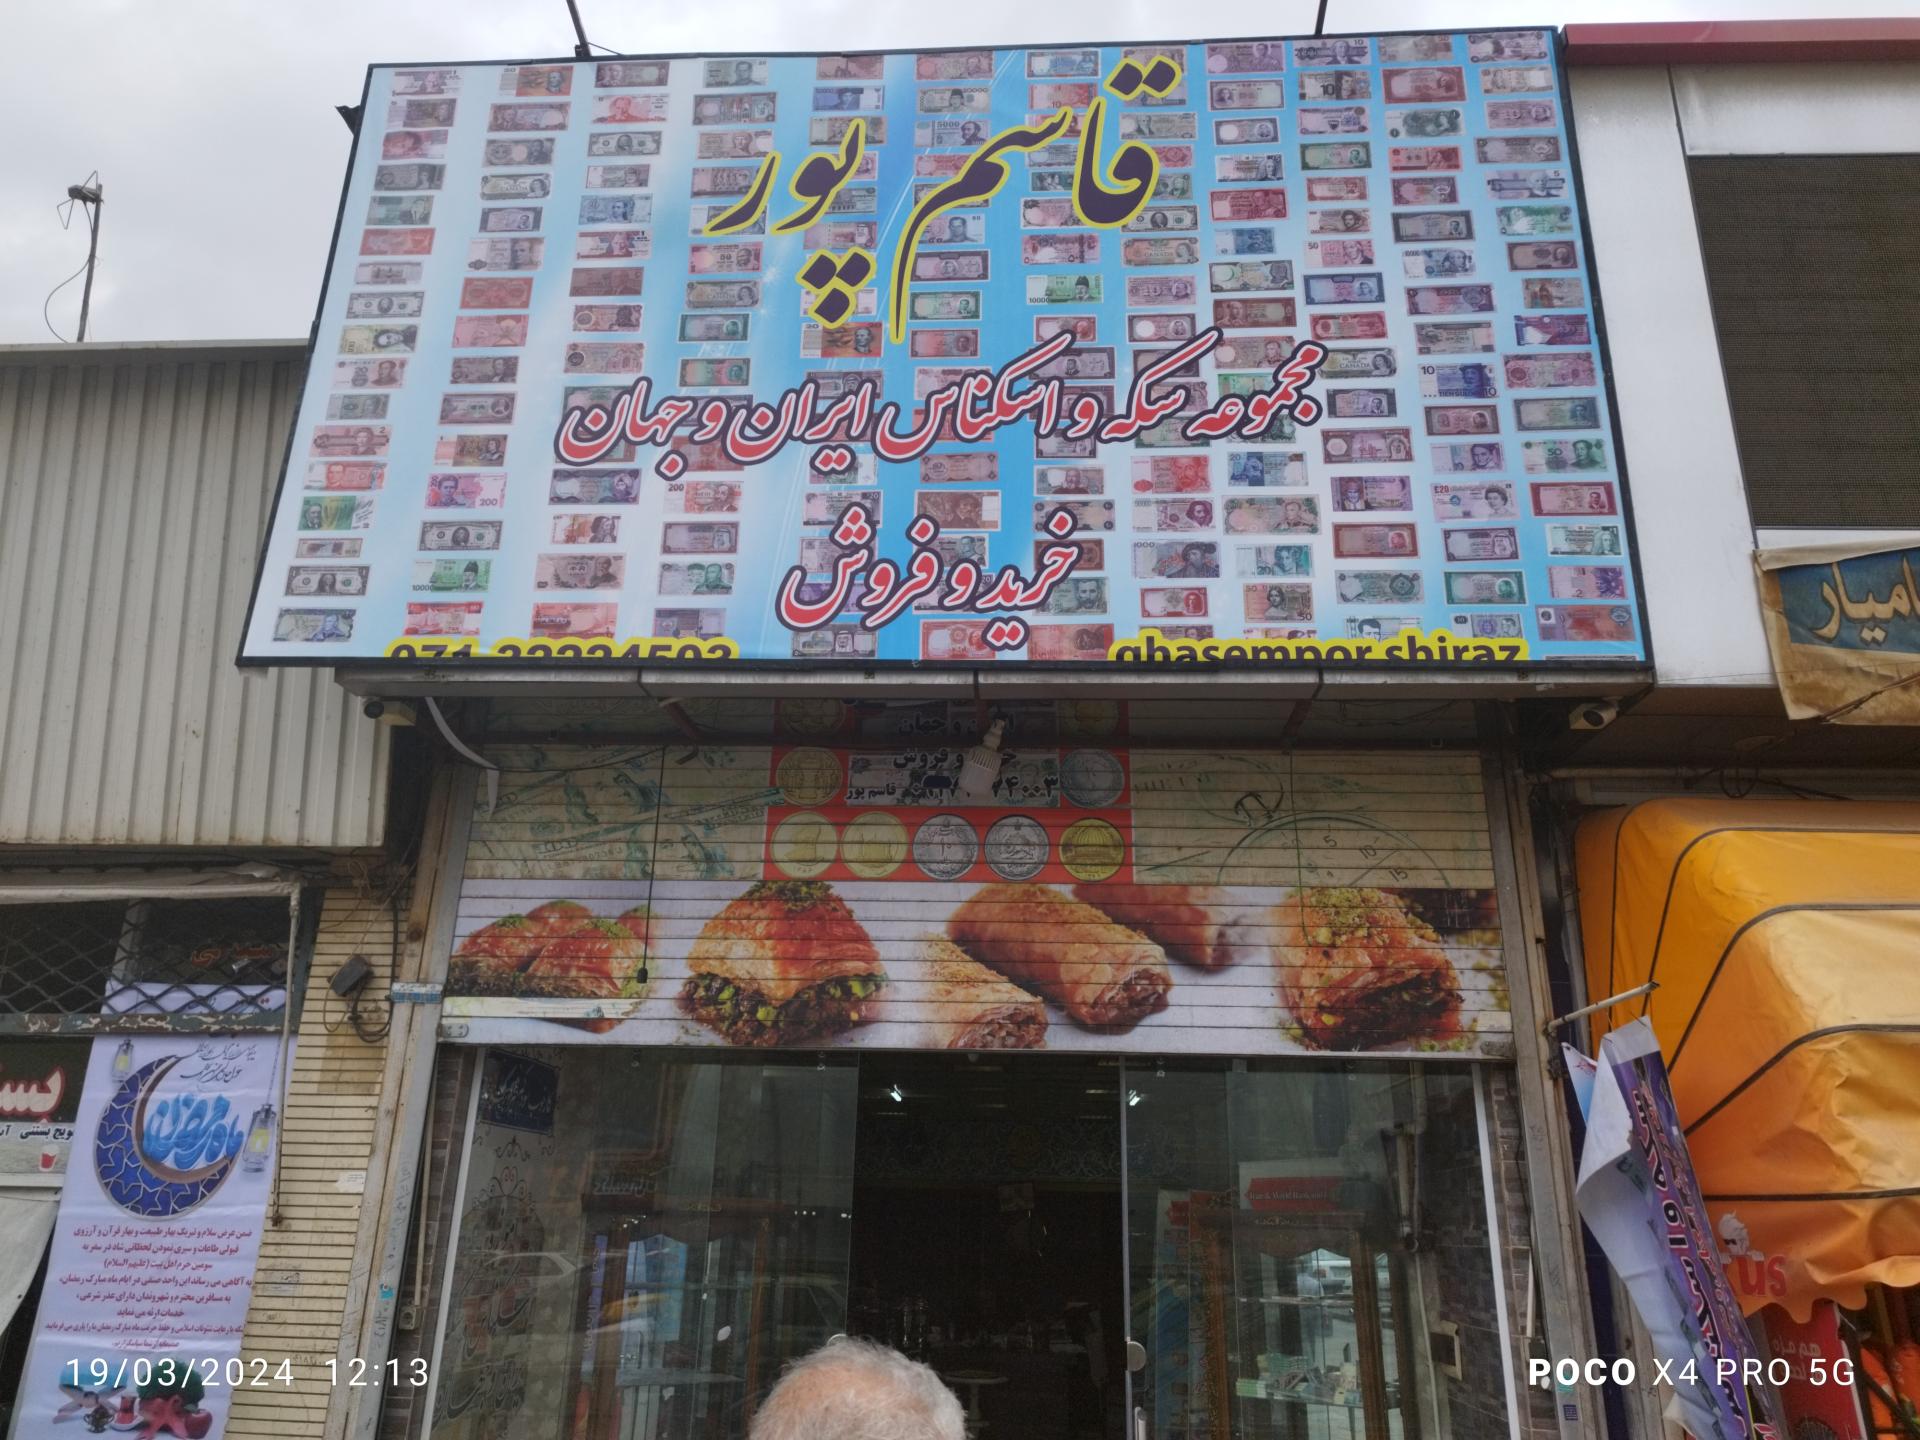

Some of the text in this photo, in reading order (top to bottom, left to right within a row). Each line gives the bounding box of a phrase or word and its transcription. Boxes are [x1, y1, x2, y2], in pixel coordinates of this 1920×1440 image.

[701, 55, 1180, 344] قاسم پور
[1421, 365, 1435, 375] 10
[555, 327, 1327, 481] مجموعه سکه و اسکناس ایران و جهان
[668, 483, 685, 492] 200
[479, 498, 498, 506] 200
[775, 502, 1082, 650] خرید و فروش
[1812, 555, 1920, 643] امیار
[1384, 636, 1521, 661] shiraz
[893, 747, 949, 769] فروش
[846, 781, 897, 801] قاسم پور
[20, 1125, 51, 1140] بستنی
